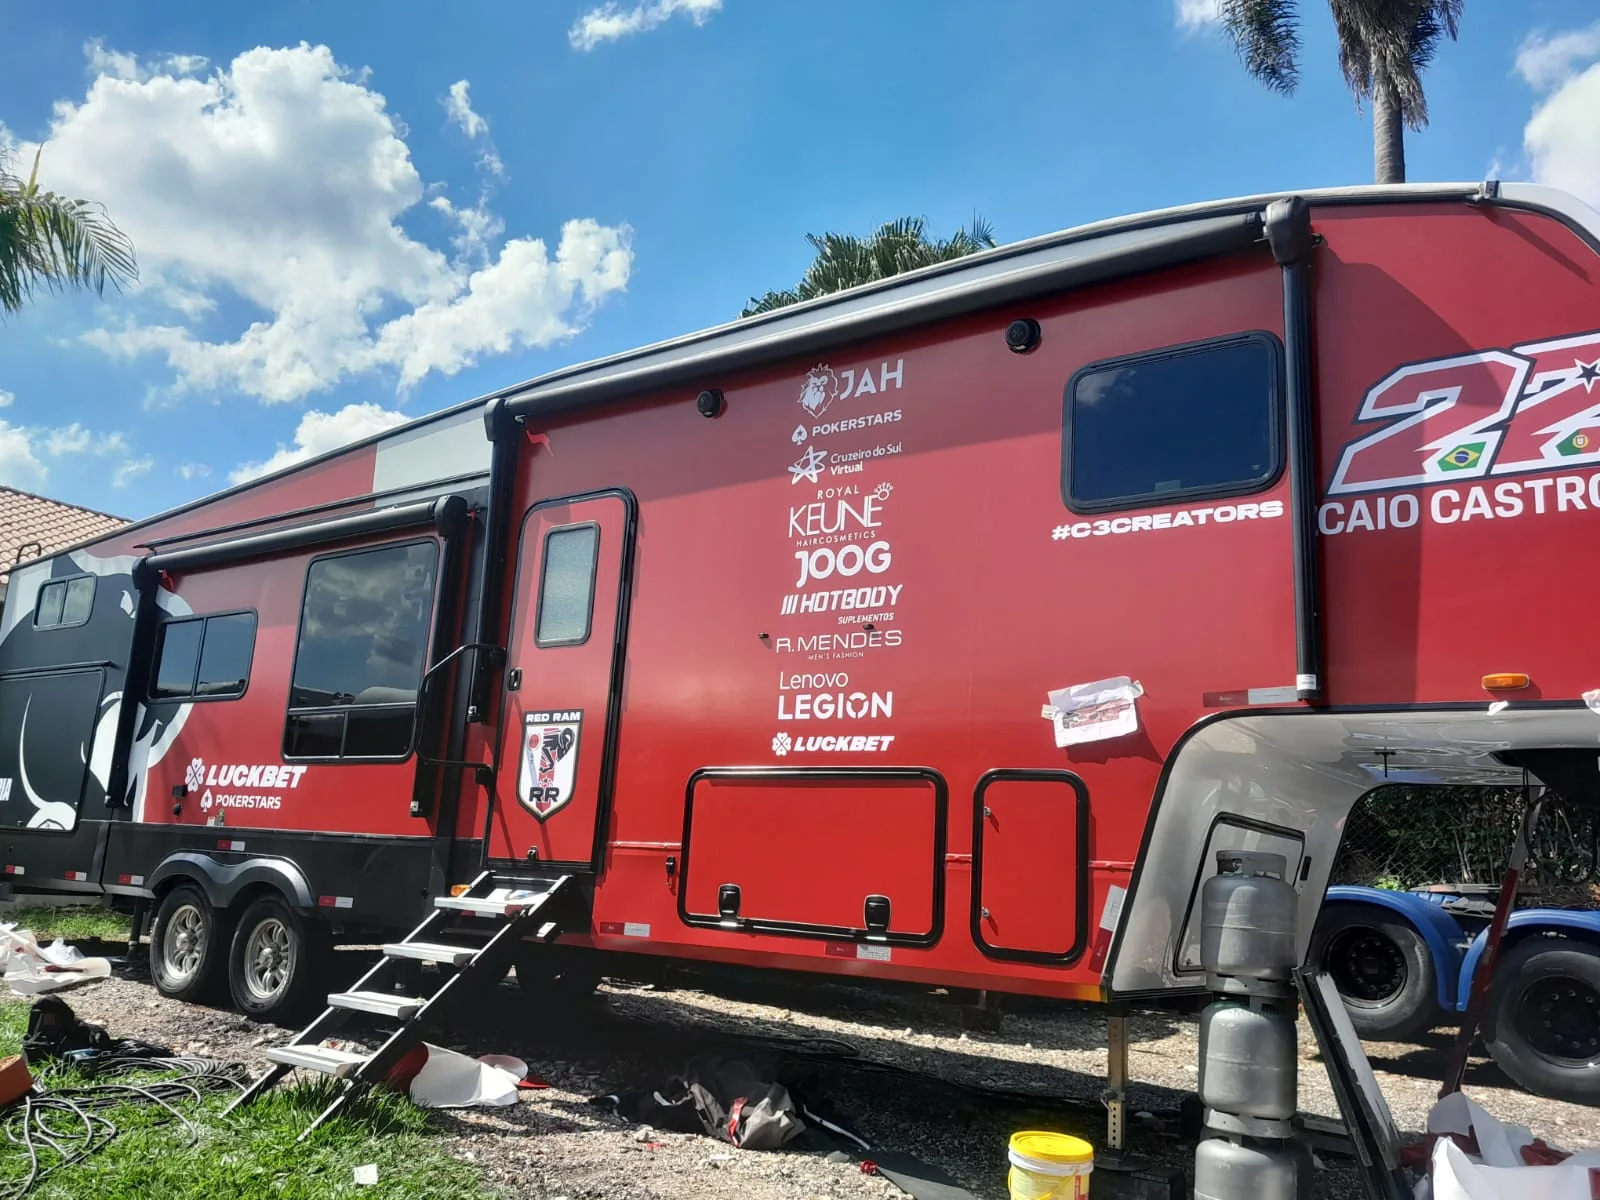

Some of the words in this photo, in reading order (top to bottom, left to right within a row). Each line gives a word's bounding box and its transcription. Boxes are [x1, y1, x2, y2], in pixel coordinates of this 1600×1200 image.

[840, 359, 904, 400] JAH
[812, 410, 903, 437] POKERSTARS
[830, 449, 872, 465] Cruzeiro
[873, 445, 886, 458] do
[887, 442, 903, 455] Sul
[830, 461, 863, 476] Virtual
[817, 485, 861, 500] ROYAL
[788, 494, 883, 538] KEUNE
[1051, 500, 1284, 541] #C3CREATORS
[1317, 493, 1420, 535] CAIO
[796, 530, 876, 548] HAIRCOSMETICS
[795, 541, 892, 588] JOOG
[837, 612, 895, 625] SUPLEMENTOS
[832, 651, 864, 659] FASHION
[779, 671, 849, 690] Lenovo
[777, 691, 893, 720] LEGION
[526, 713, 550, 723] RED
[552, 711, 581, 722] RAM
[793, 735, 895, 752] LUCKBET
[205, 764, 308, 788] LUCKBET
[215, 794, 282, 809] POKERSTARS
[528, 786, 560, 802] RR
